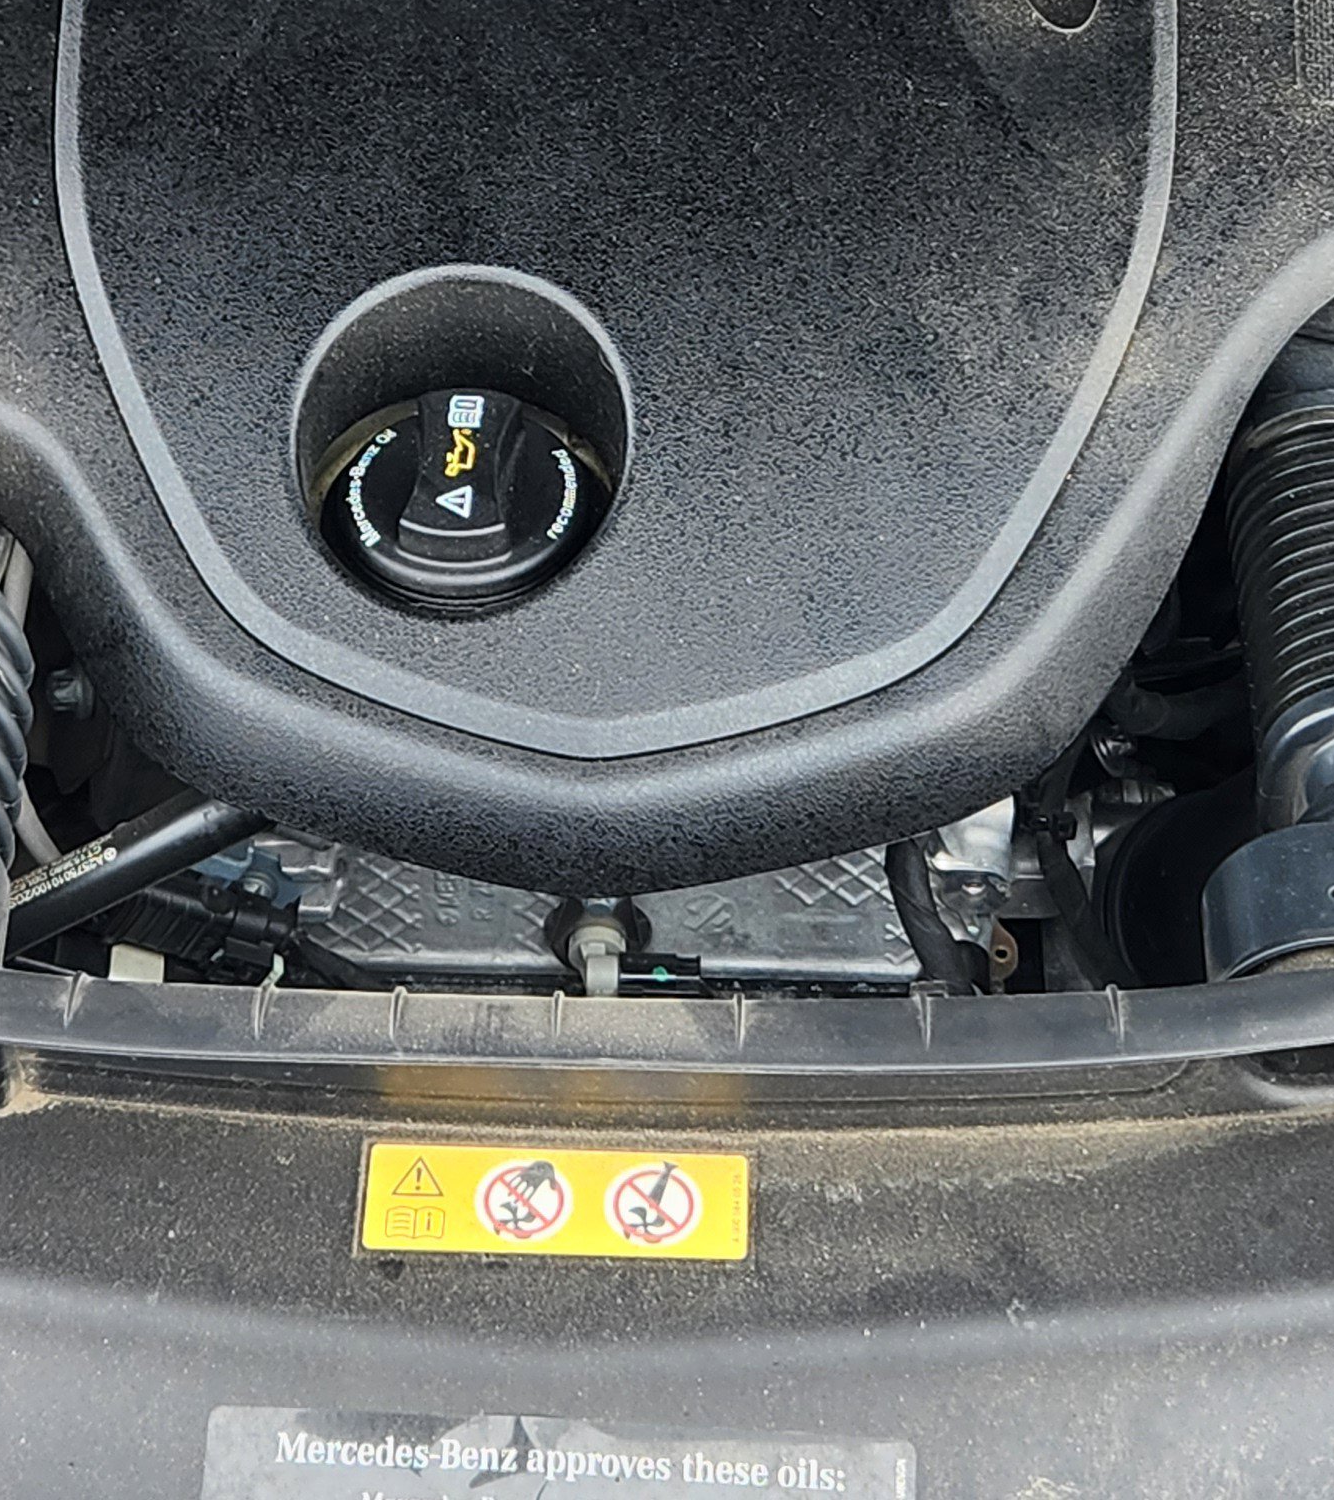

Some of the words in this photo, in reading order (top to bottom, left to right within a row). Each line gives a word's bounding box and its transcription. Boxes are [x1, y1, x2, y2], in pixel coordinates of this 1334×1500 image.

[546, 449, 579, 540] recommended
[274, 1431, 518, 1473] Mercedes-Benz
[526, 1446, 671, 1482] approves
[681, 1452, 770, 1488] these
[777, 1456, 847, 1492] oils:
